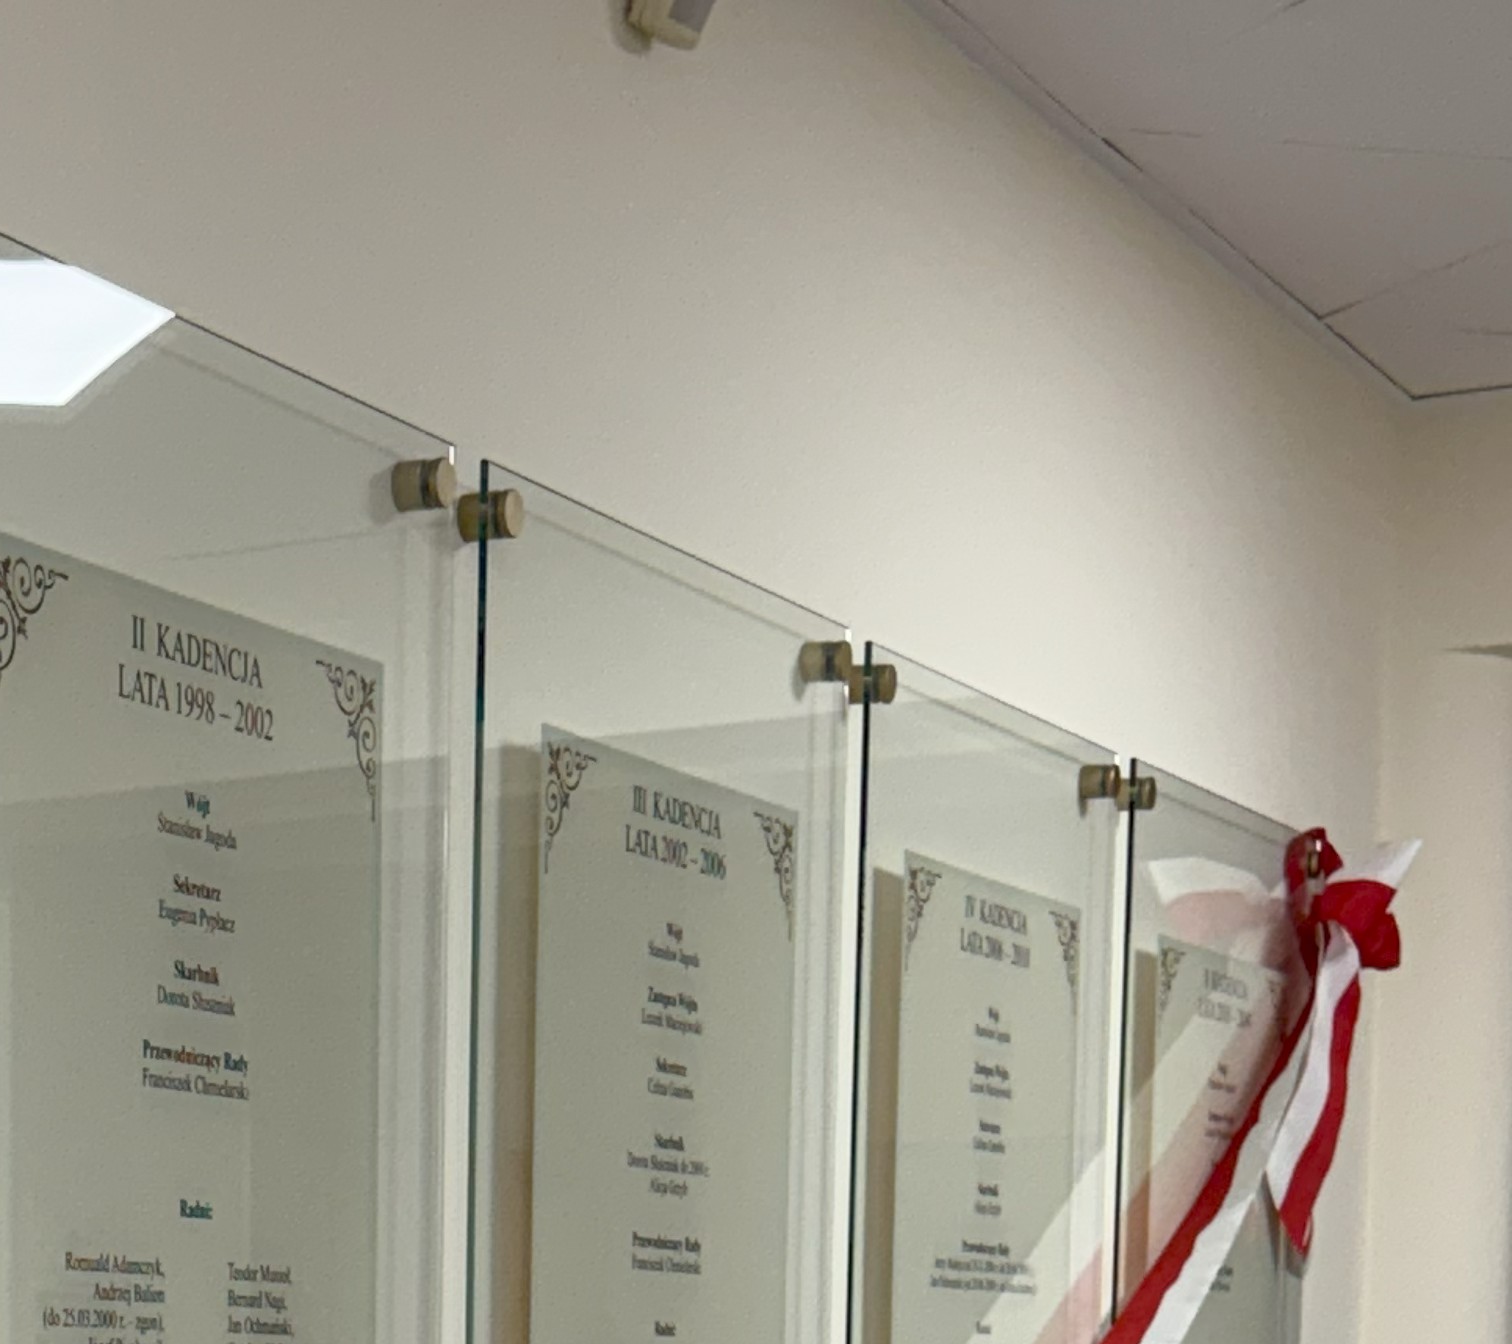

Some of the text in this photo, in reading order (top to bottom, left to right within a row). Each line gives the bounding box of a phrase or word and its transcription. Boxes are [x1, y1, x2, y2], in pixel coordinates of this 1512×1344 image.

[130, 614, 263, 689] II KADENCJA
[117, 662, 170, 712] LATA
[175, 681, 216, 725] 1998
[233, 698, 273, 742] 2002
